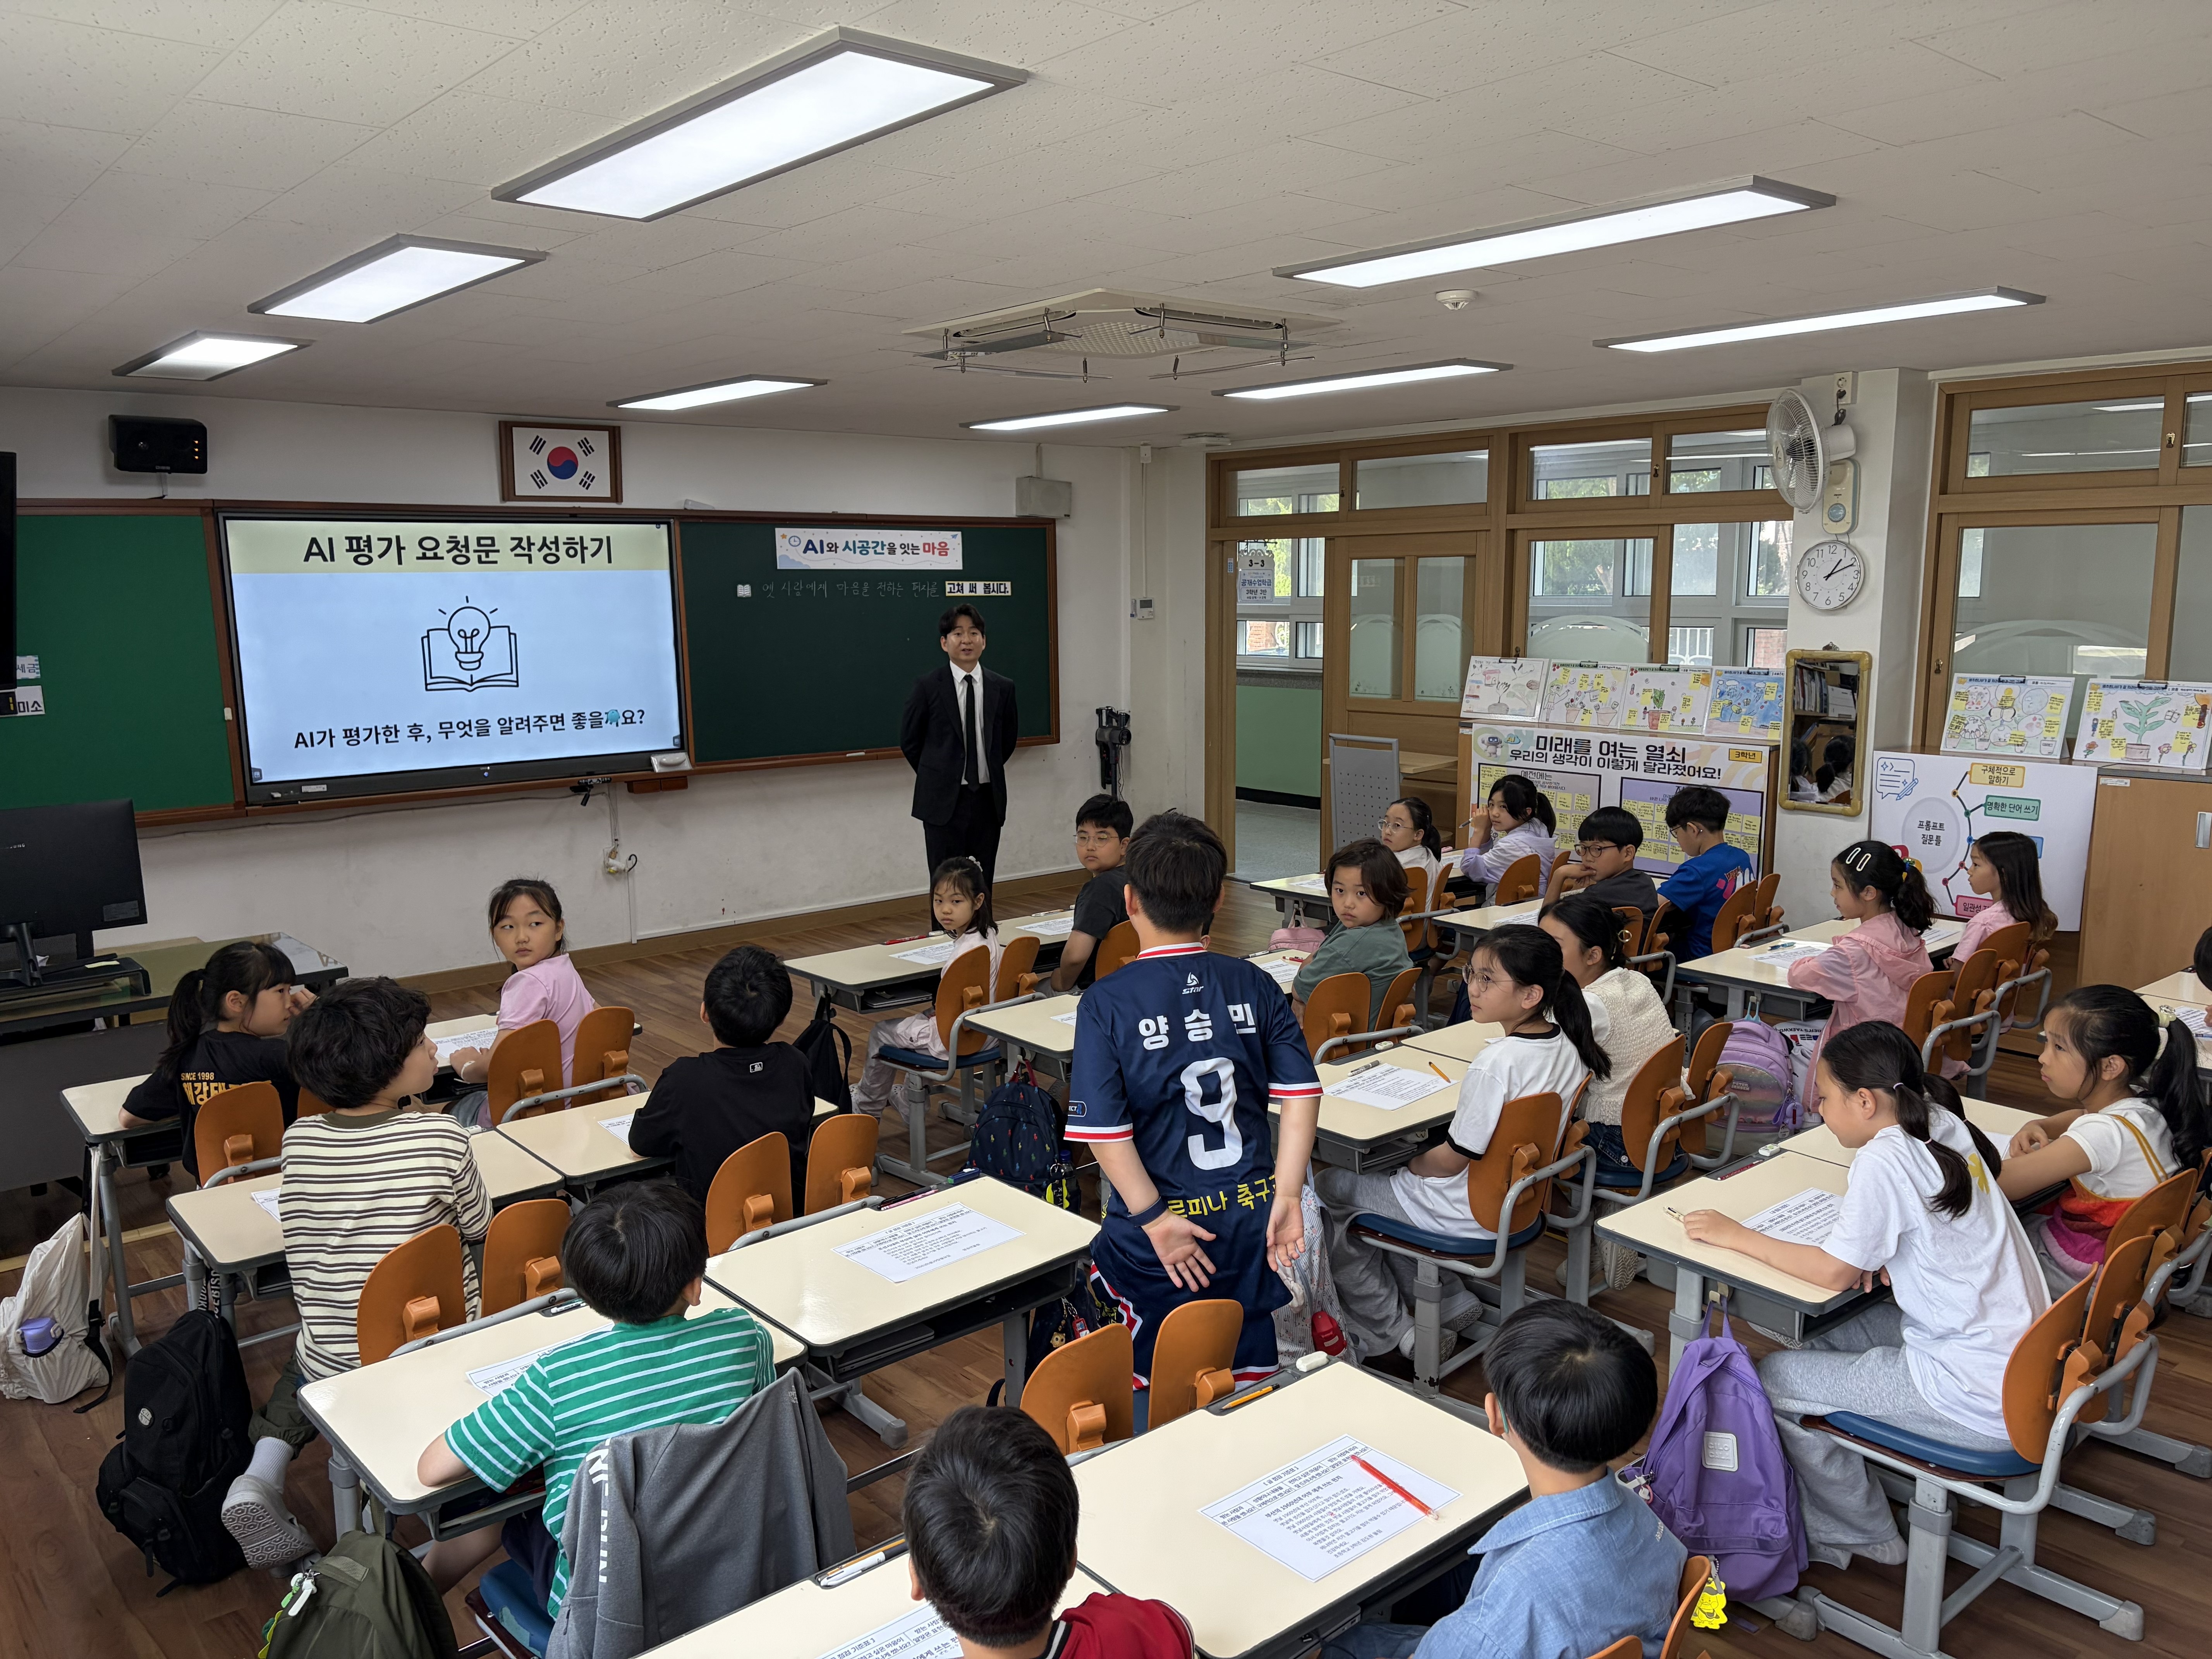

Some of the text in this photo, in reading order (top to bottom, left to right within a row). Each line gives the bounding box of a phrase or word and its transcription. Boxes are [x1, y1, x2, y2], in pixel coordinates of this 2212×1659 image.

[303, 534, 613, 567] AI 평가 요청문 작성하기
[803, 539, 950, 556] AI와 시공간을 잇는 마음
[1828, 546, 1837, 555] 12
[1843, 549, 1847, 557] 1
[1816, 549, 1824, 558] 11
[1807, 558, 1816, 567] 10
[1802, 570, 1808, 579] 9
[1853, 570, 1859, 579] 3
[781, 581, 828, 598] 사람에게
[836, 582, 870, 598] 마음을
[876, 581, 903, 599] 전하는
[912, 580, 940, 599] 편지를
[947, 583, 1010, 595] 고쳐 써 봅시다.
[1805, 582, 1811, 591] 8
[1847, 582, 1854, 591] 4
[1813, 592, 1819, 601] 7
[1825, 596, 1831, 605] 6
[1838, 592, 1845, 602] 5
[17, 701, 43, 713] 미소
[294, 730, 336, 749] AI가
[342, 724, 400, 746] 평가한
[407, 722, 432, 745] 후,
[438, 717, 491, 741] 무엇을
[496, 713, 566, 737] 알려주면
[1535, 735, 1686, 764] 미래를 여는 열쇠
[1735, 750, 1756, 761] 3학년
[1510, 749, 1722, 780] 우리의 생각이 이렇게 달라졌어요!
[1521, 770, 1553, 781] 예전에는
[1981, 765, 2016, 776] 구체적으로
[1988, 775, 2009, 786] 말하기
[1987, 801, 2039, 815] 명확한 단어 쓰기
[1917, 820, 1945, 831] 프롬프트
[1921, 834, 1934, 845] 질문
[1963, 902, 1982, 913] 일관성
[181, 1072, 214, 1080] SINCE 1998
[1180, 1057, 1243, 1170] 9
[1265, 1508, 1282, 1518] 부산의
[1280, 1496, 1304, 1510] 1960년대
[914, 1626, 928, 1634] 받는
[912, 1631, 932, 1643] 알맞은
[851, 1640, 871, 1652] 기준표
[872, 1637, 905, 1656] 싶은 마음이
[890, 1641, 912, 1655] 썼나요?
[934, 1642, 951, 1653] 쓰는
